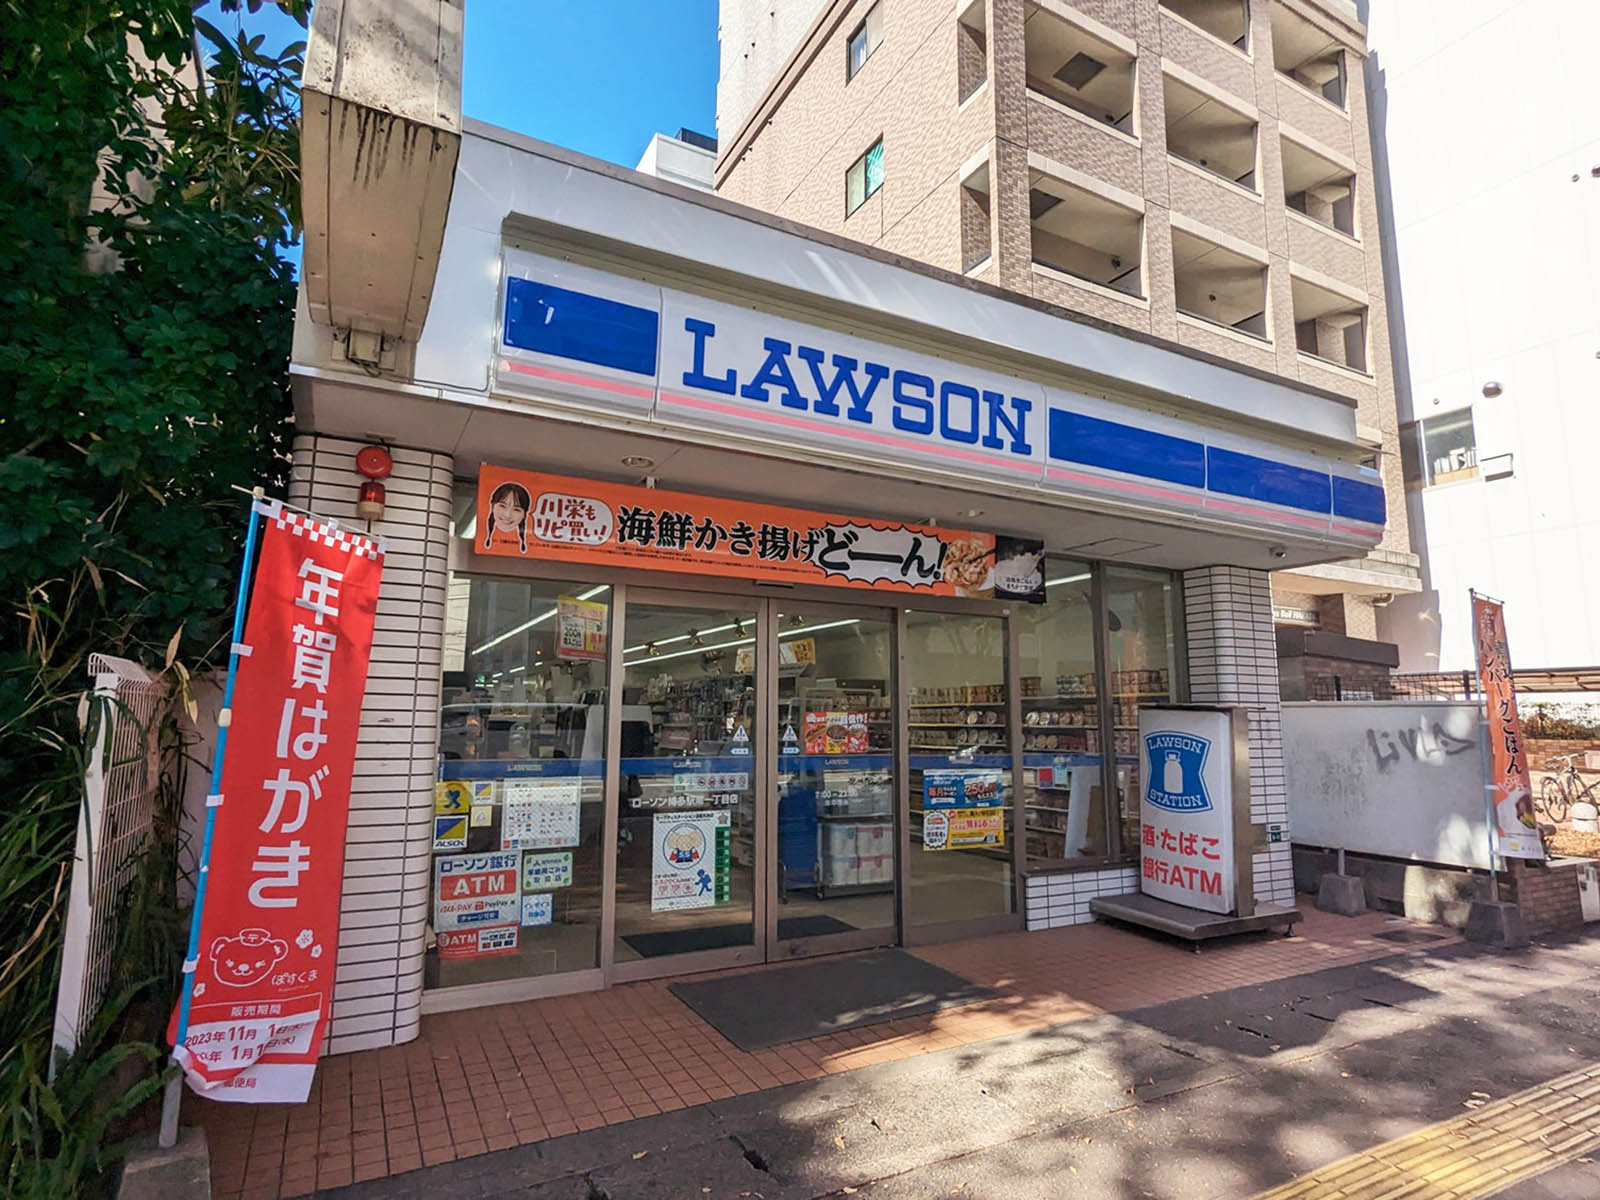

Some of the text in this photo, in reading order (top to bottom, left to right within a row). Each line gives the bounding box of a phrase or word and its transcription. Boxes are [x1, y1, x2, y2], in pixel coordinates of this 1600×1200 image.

[682, 317, 1032, 455] LAWSON
[540, 498, 596, 520] 川栄も
[247, 557, 344, 908] 年賀はがき
[1148, 736, 1204, 754] LAWSON
[1149, 789, 1204, 807] STATION
[435, 840, 465, 848] ALSOK
[1142, 823, 1221, 860] 酒・たばこ
[440, 854, 518, 873] ローソン銀行
[453, 874, 505, 896] ATM
[1142, 857, 1223, 896] 銀行ATM
[457, 902, 472, 913] PAY
[450, 933, 477, 946] ATM
[271, 969, 318, 987] ぽすくま
[230, 1003, 281, 1018] 販売期間
